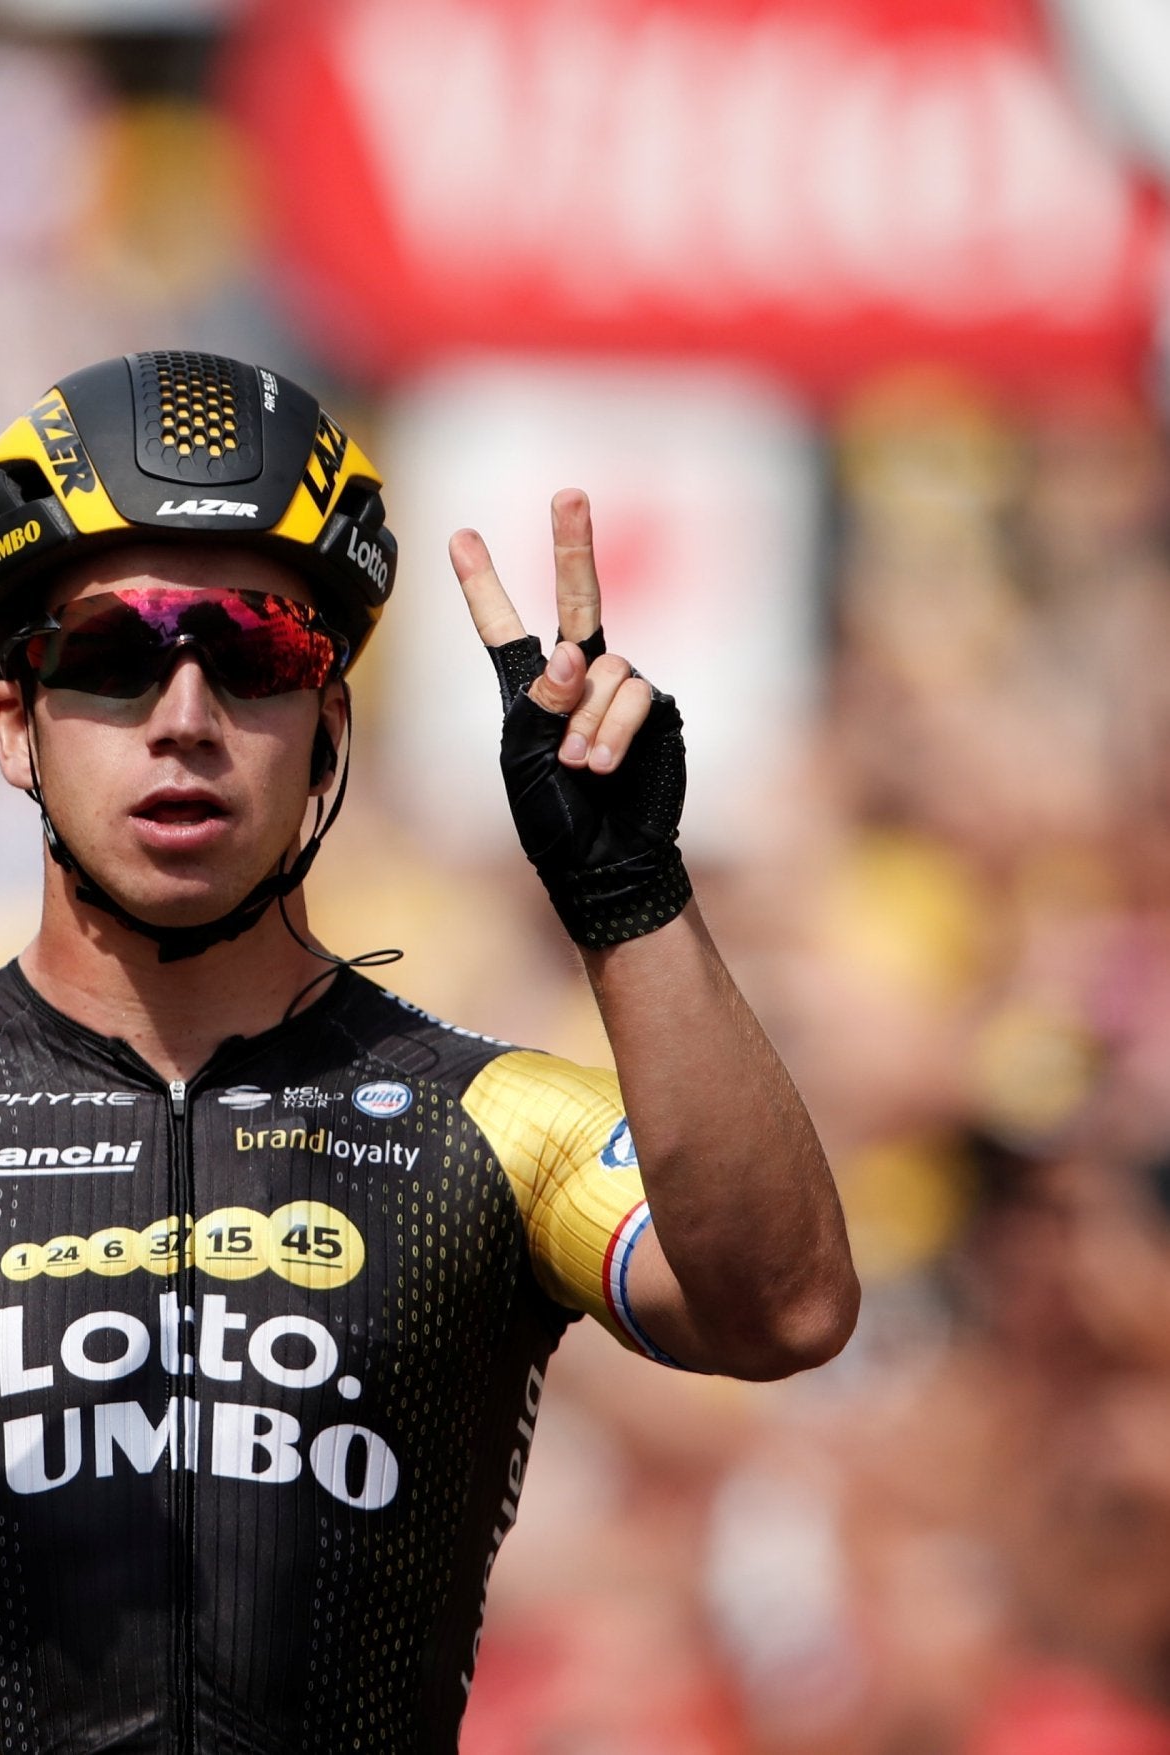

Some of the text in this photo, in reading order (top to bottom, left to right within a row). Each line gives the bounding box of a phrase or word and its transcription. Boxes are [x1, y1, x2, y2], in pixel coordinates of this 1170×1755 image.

[264, 391, 276, 413] AIR
[156, 499, 259, 518] LAZER
[282, 1100, 329, 1109] TOUR
[283, 1093, 345, 1101] WORLD
[235, 1127, 420, 1171] brandloyalty
[16, 1252, 28, 1266] 1
[47, 1245, 80, 1262] 24
[103, 1240, 124, 1258] 6
[207, 1226, 252, 1253] 15
[281, 1223, 343, 1259] 45
